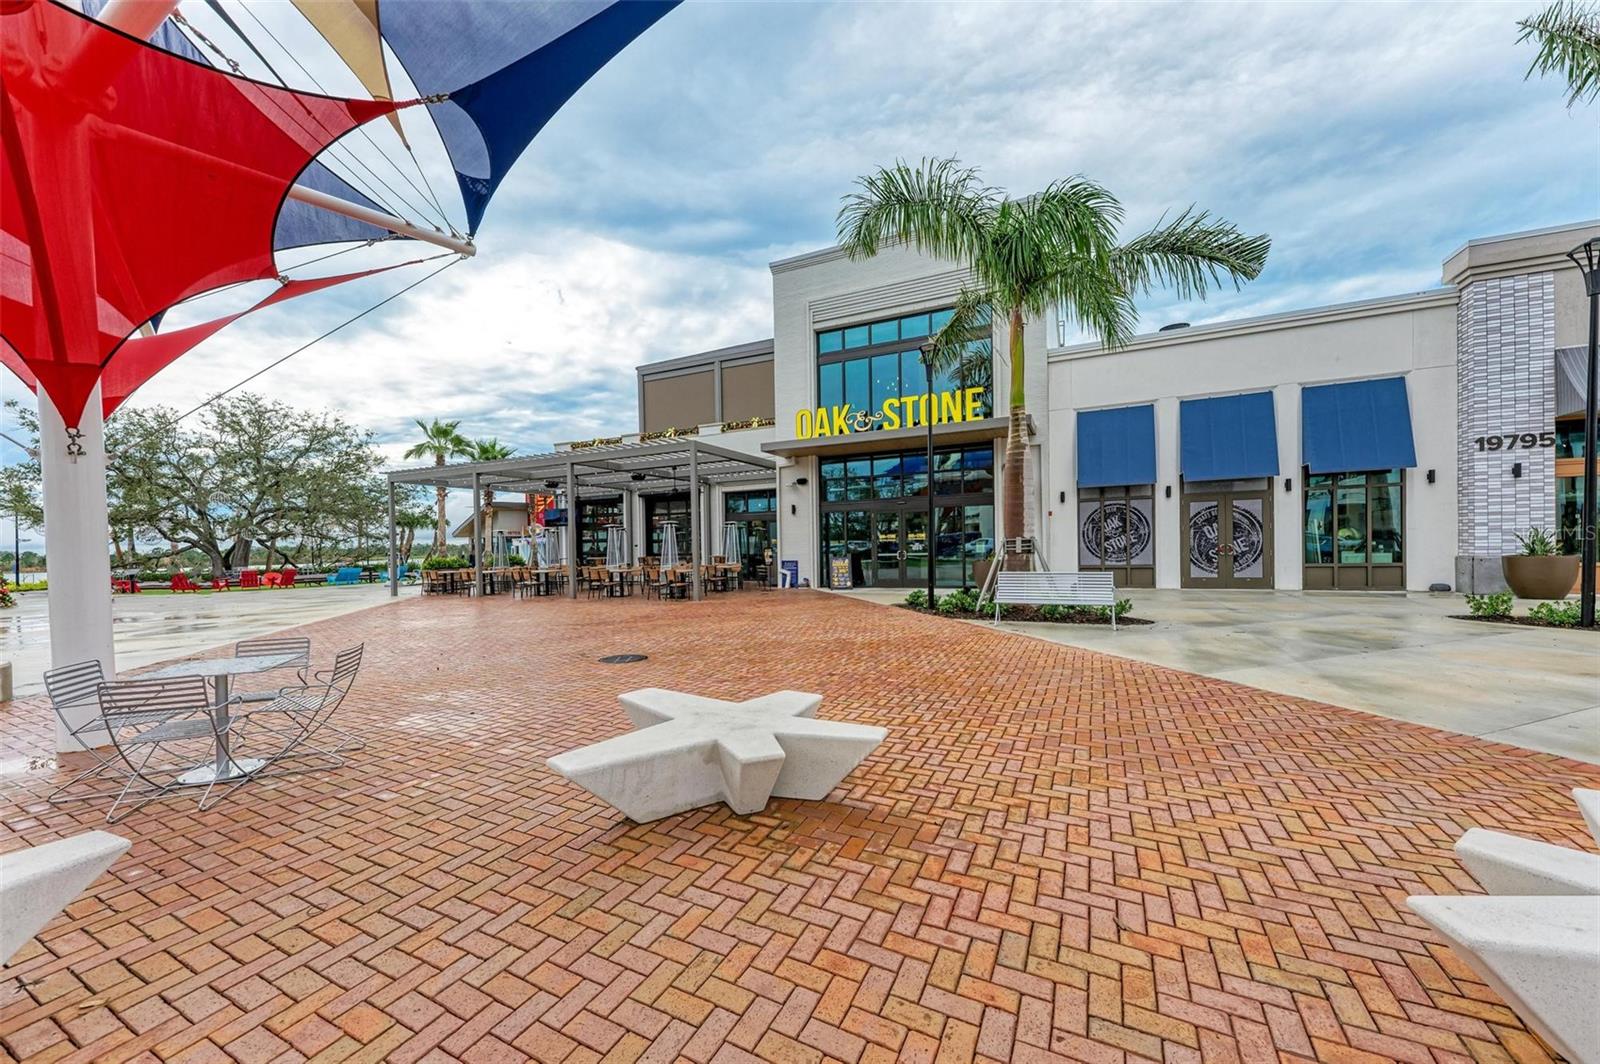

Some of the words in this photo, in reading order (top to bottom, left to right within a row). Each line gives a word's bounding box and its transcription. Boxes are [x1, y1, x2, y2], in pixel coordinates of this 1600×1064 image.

[795, 403, 850, 440] OAK
[845, 410, 884, 432] &
[882, 386, 985, 431] STONE
[1474, 431, 1556, 452] 19795
